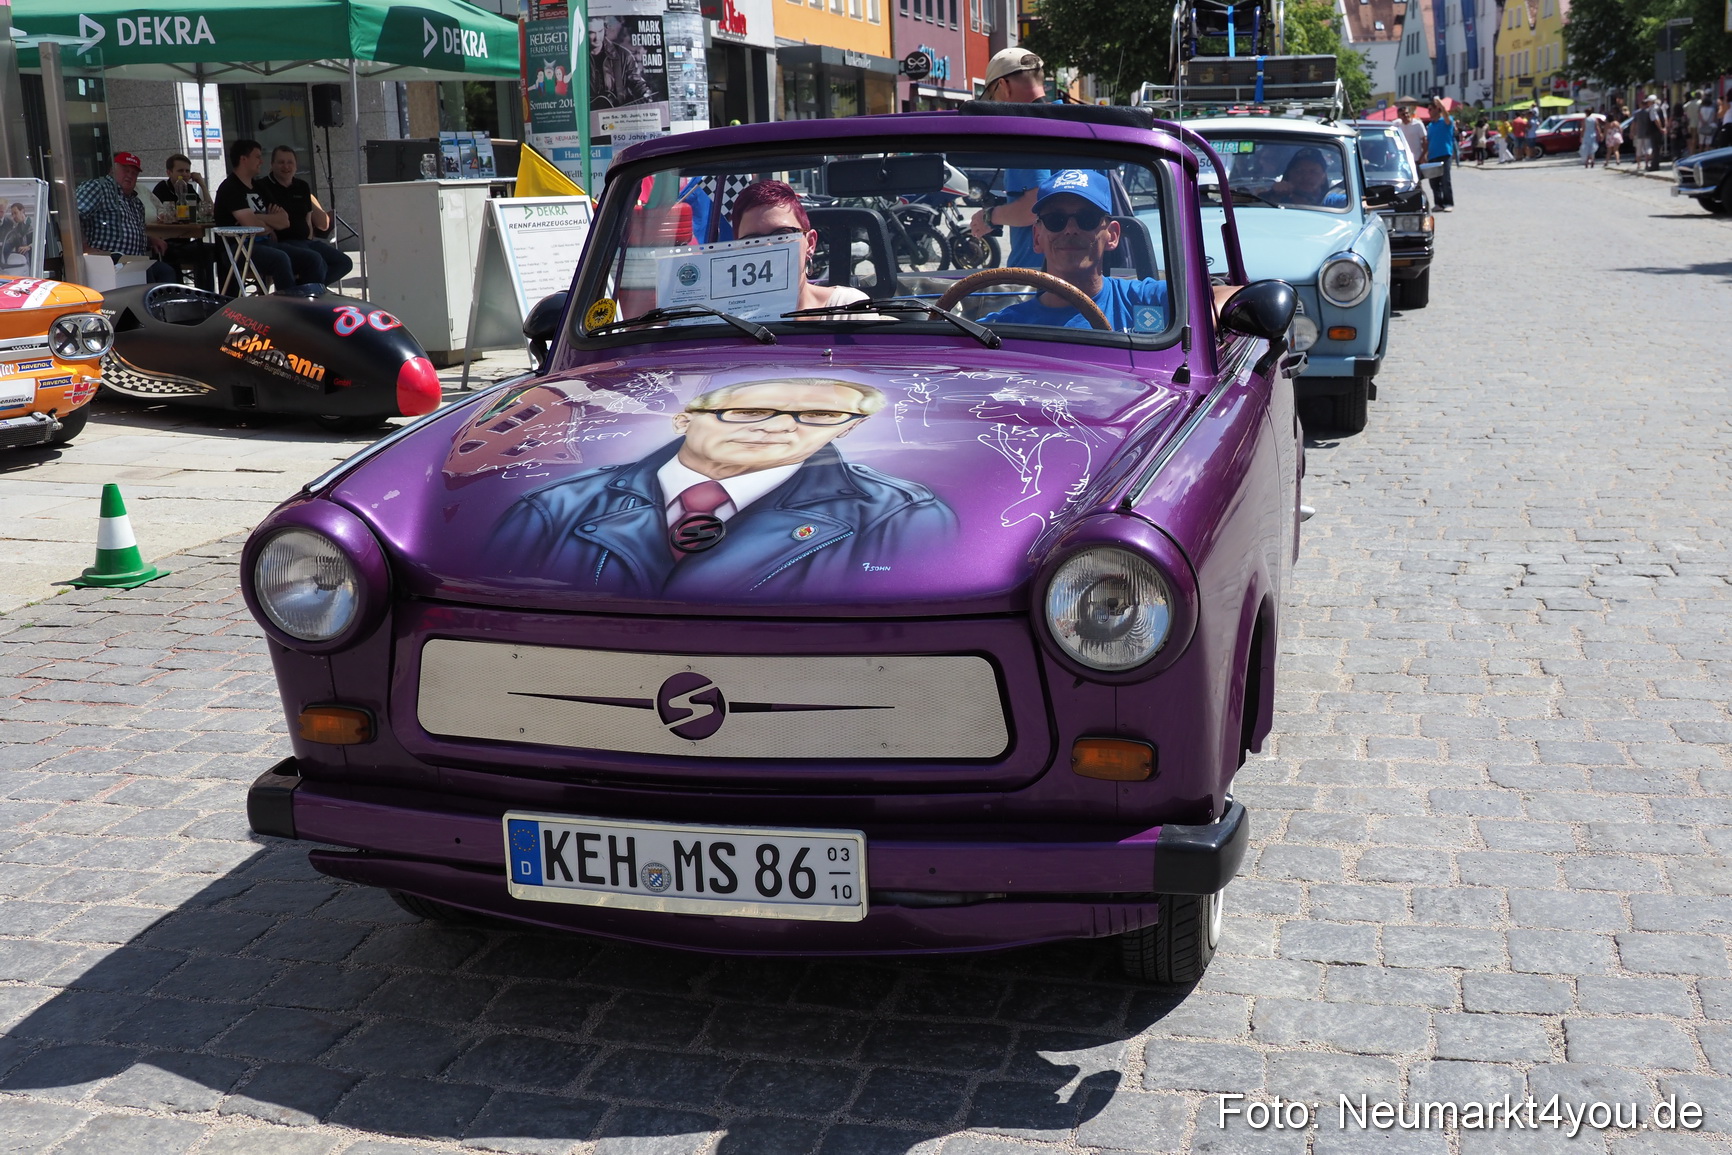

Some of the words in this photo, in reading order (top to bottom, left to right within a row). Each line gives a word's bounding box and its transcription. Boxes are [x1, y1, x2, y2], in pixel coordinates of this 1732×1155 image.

[117, 15, 216, 47] DEKRA
[638, 20, 660, 32] MARK
[443, 26, 489, 58] DEKRA
[530, 31, 568, 46] KELTEN
[632, 33, 661, 46] BENDER
[642, 53, 662, 66] BAND
[530, 100, 558, 110] Sommer
[590, 149, 601, 158] ell
[536, 205, 569, 217] DEKRA
[508, 218, 588, 230] RENNFAHRZEUGSCHAU
[726, 259, 774, 288] 134
[221, 307, 271, 336] FAHRSCHULE
[224, 323, 326, 382] Kohlmann
[21, 362, 50, 370] RAVENOL
[42, 378, 69, 387] RAVENOL
[827, 847, 851, 862] 03
[521, 860, 532, 876] D
[543, 829, 638, 888] KEH
[673, 839, 739, 894] MS
[754, 843, 817, 900] 86
[830, 885, 853, 900] 10
